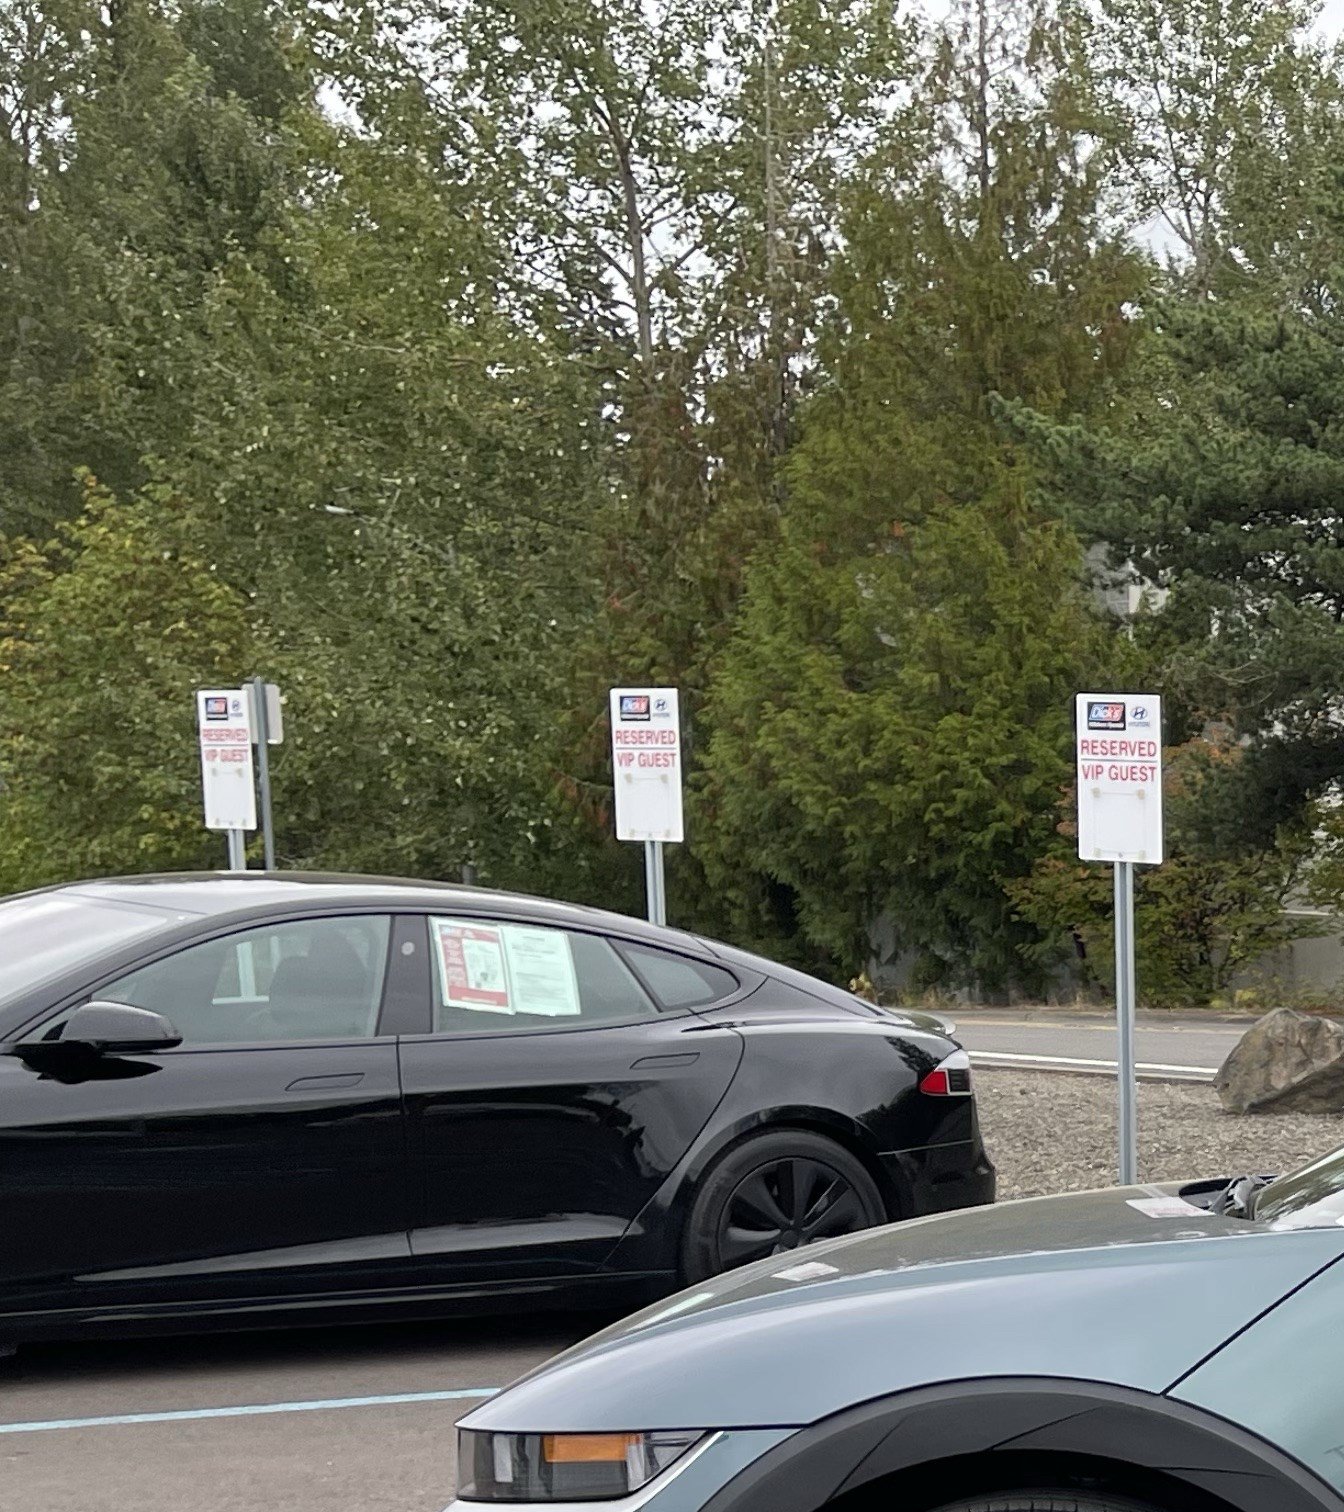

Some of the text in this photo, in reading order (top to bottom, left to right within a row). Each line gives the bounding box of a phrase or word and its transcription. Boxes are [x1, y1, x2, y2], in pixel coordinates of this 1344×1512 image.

[615, 730, 676, 745] RESERVED
[1081, 740, 1157, 757] RESERVED
[617, 752, 677, 768] VIP GUEST
[1082, 765, 1157, 782] VIP GUEST
